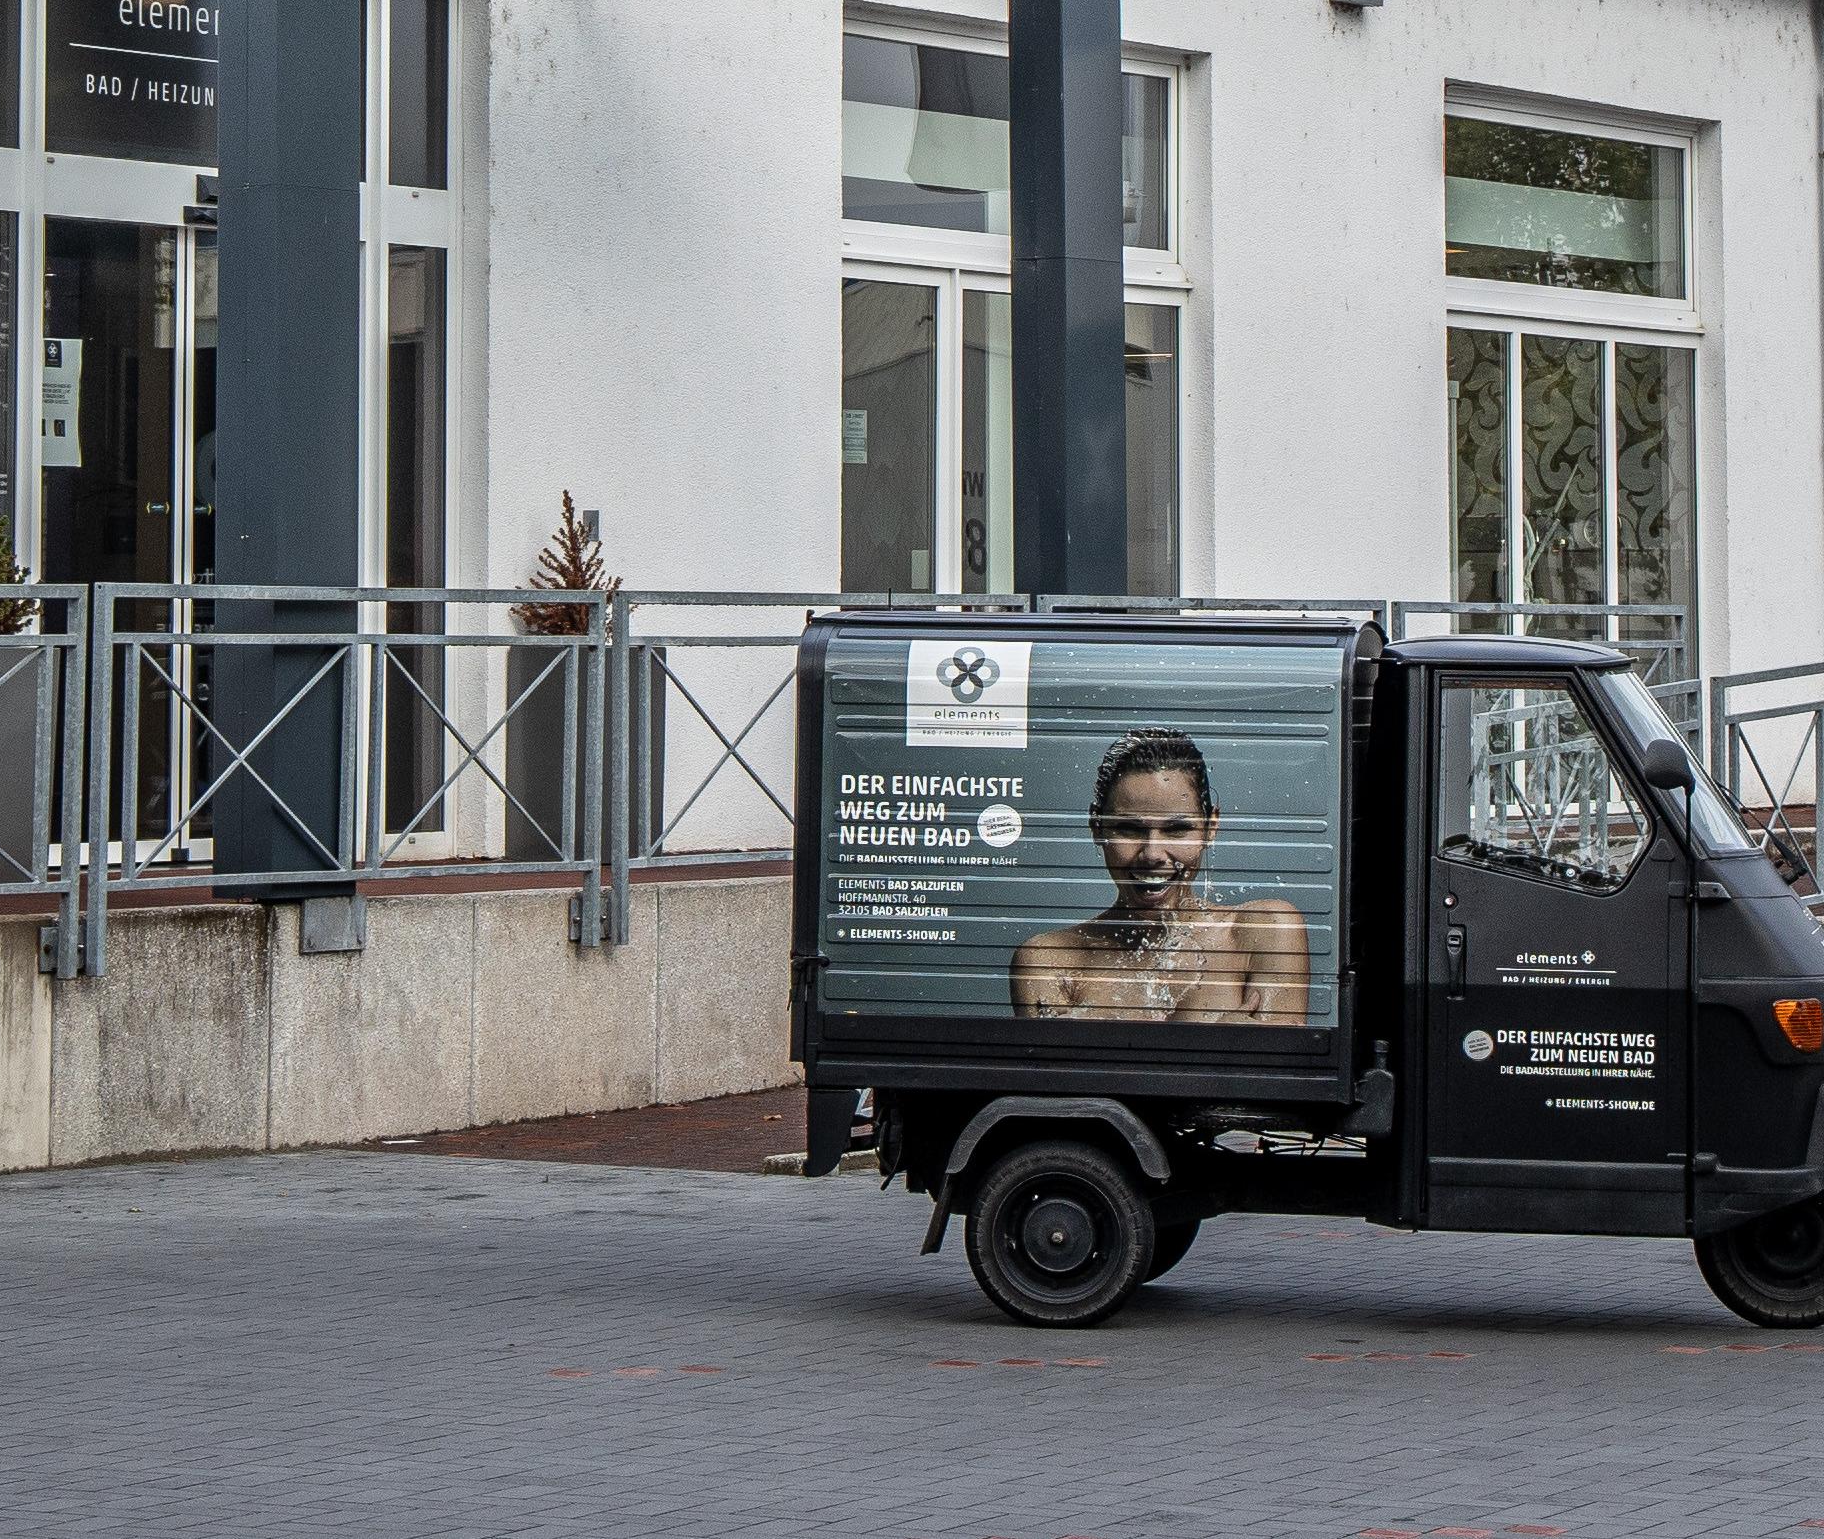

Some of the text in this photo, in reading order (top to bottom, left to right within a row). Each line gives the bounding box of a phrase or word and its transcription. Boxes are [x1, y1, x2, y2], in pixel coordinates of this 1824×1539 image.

[86, 74, 122, 96] BAD
[148, 81, 214, 107] HEIZUN
[934, 708, 1000, 721] elements
[840, 774, 1024, 799] DER EINFACHSTE
[839, 800, 945, 822] WEG ZUM
[839, 825, 971, 848] NEUEN BAD
[839, 854, 856, 863] DIE
[838, 879, 964, 892] ELEMENTS BAD SALZUFLEN
[838, 892, 926, 904] HOFFMANNSTR. 40
[838, 905, 949, 917] 32105 BAD SALZUFLEN
[850, 928, 956, 941] ELEMENTS-SHOW.DE
[1516, 952, 1578, 965] elements
[1502, 975, 1519, 983] BAD
[1528, 976, 1566, 984] HEIZUNG
[1575, 977, 1610, 986] ENERGIE
[1497, 1029, 1655, 1048] DER EINFACHSTE WEG
[1530, 1048, 1655, 1065] ZUM NEUEN BAD
[1500, 1065, 1655, 1078] DIE BADAUSSTELLUNG IN IHRER NÄHE.
[1555, 1098, 1656, 1111] ELEMENTS-SHOW.DE
